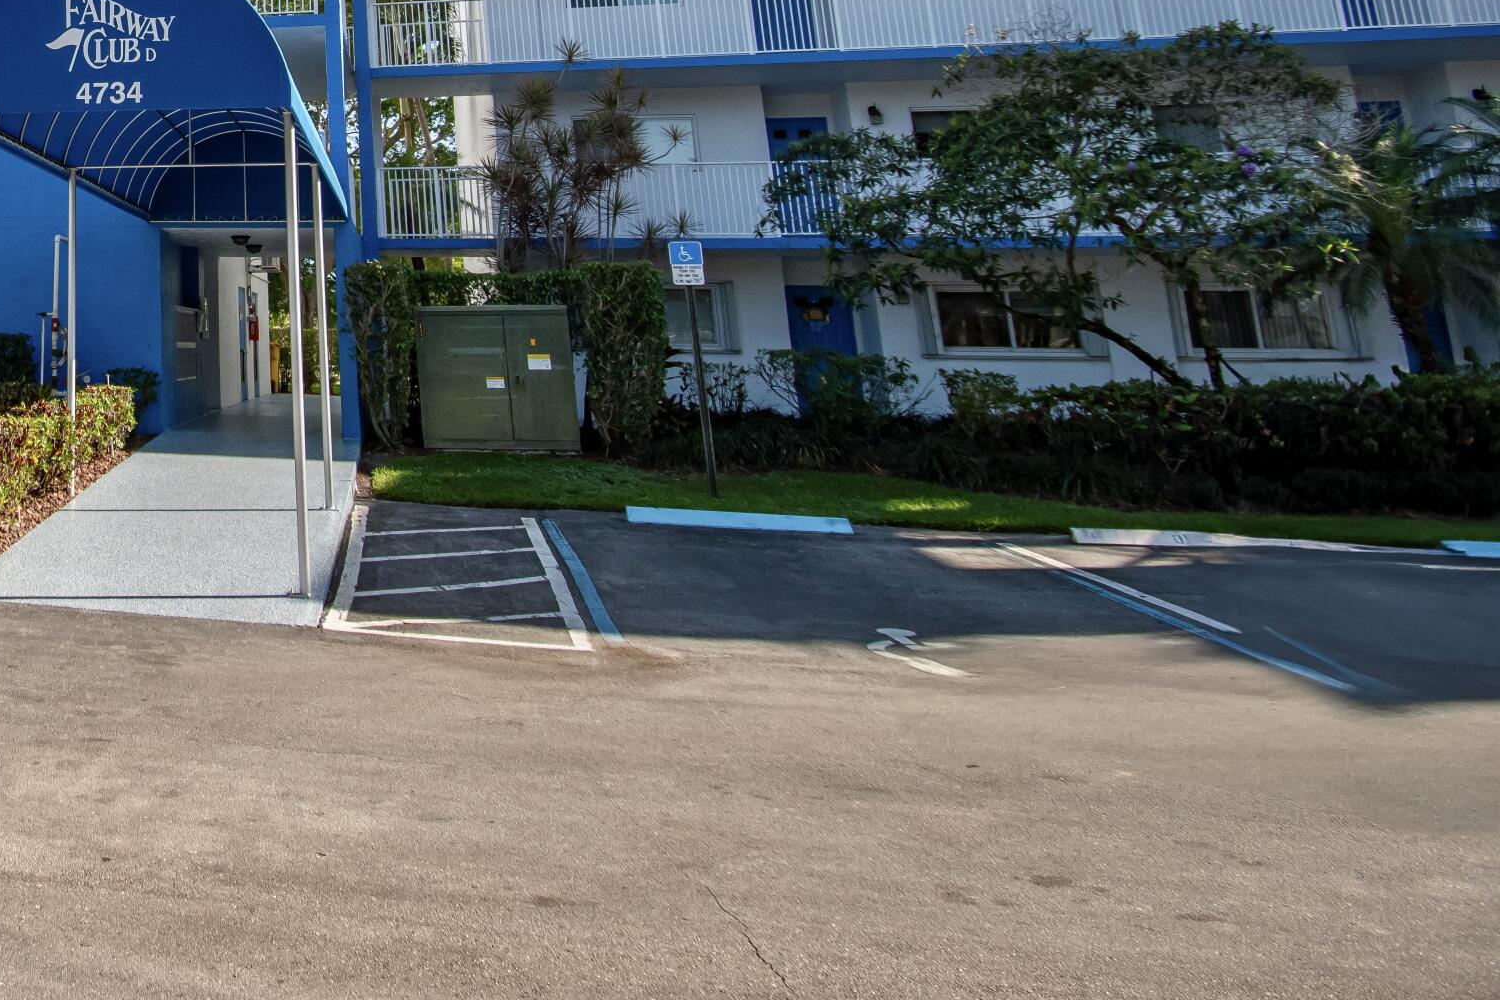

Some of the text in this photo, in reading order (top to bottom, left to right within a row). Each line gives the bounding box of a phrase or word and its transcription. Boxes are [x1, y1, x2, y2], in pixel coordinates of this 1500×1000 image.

[82, 27, 157, 70] CLUB D
[75, 81, 143, 105] 4734
